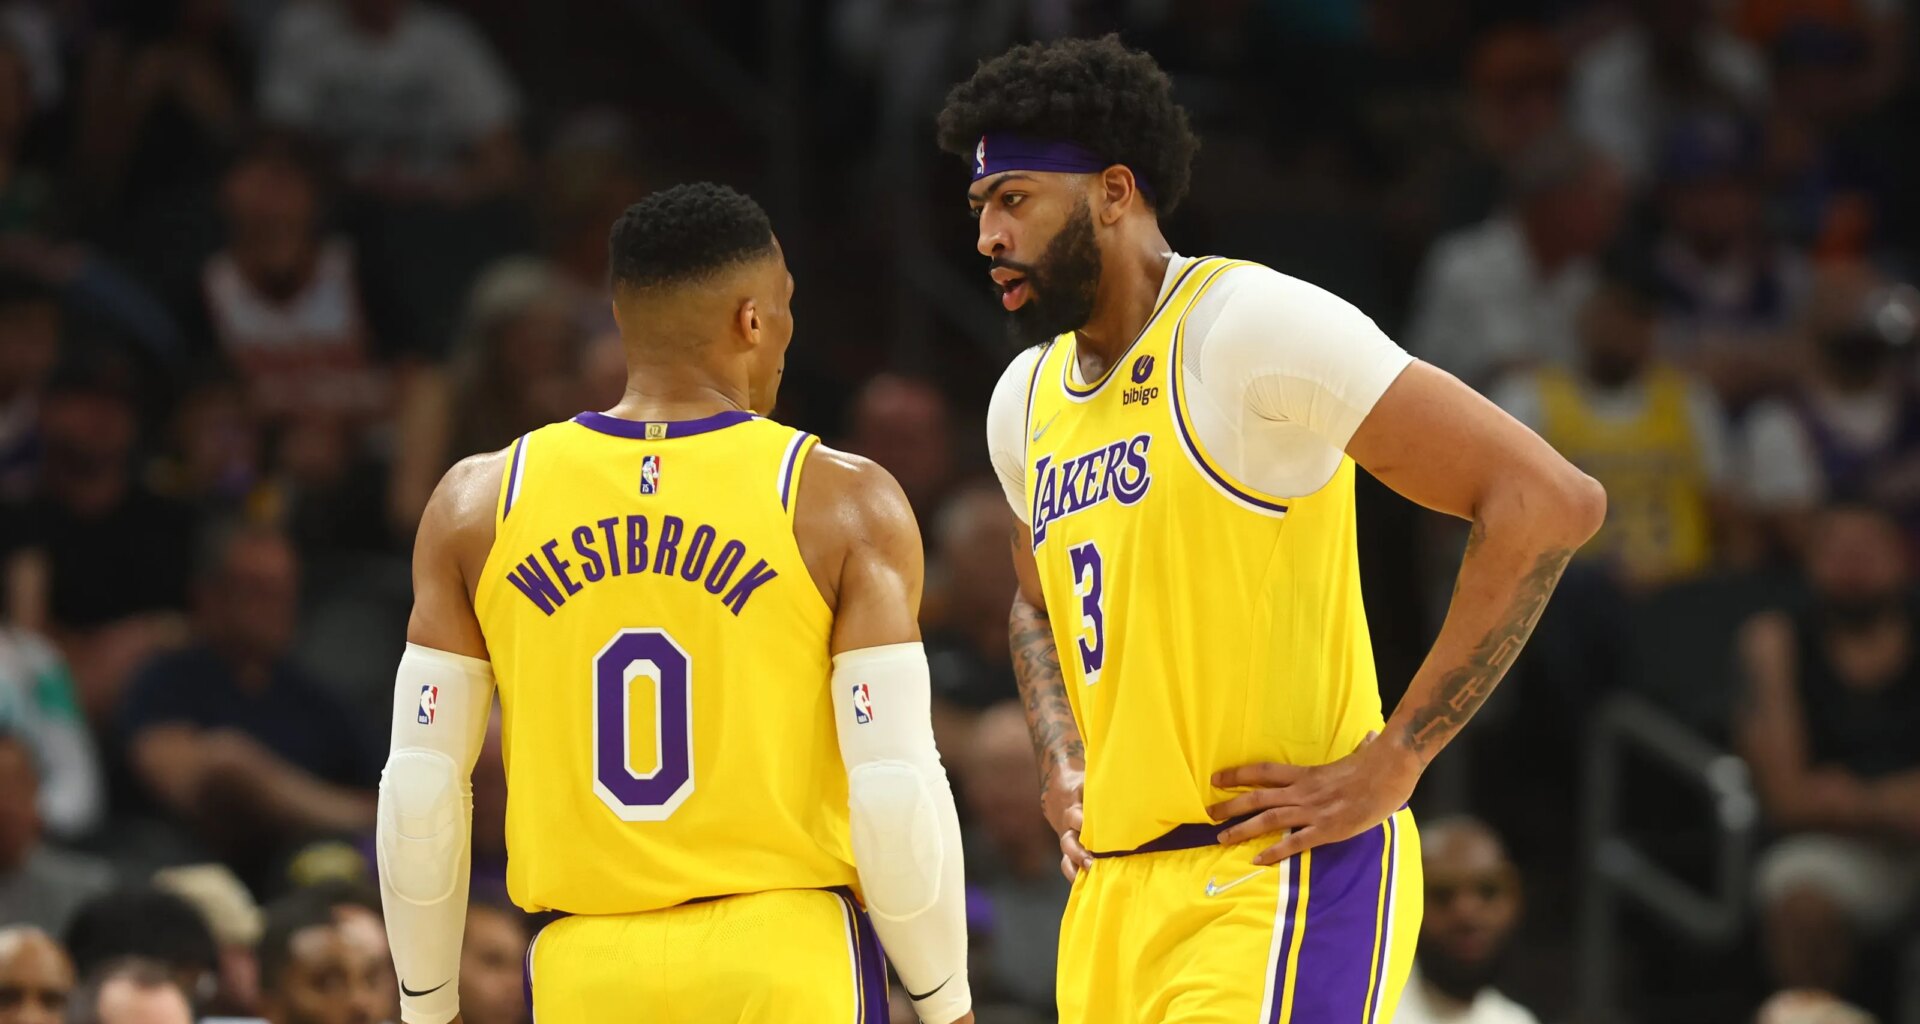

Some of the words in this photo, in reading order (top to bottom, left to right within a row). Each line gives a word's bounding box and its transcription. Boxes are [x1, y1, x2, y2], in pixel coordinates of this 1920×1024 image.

[1123, 386, 1159, 406] bibigo
[1032, 433, 1151, 553] LAKERS
[506, 514, 778, 617] WESTBROOK
[1069, 541, 1103, 681] 3
[594, 628, 694, 819] 0
